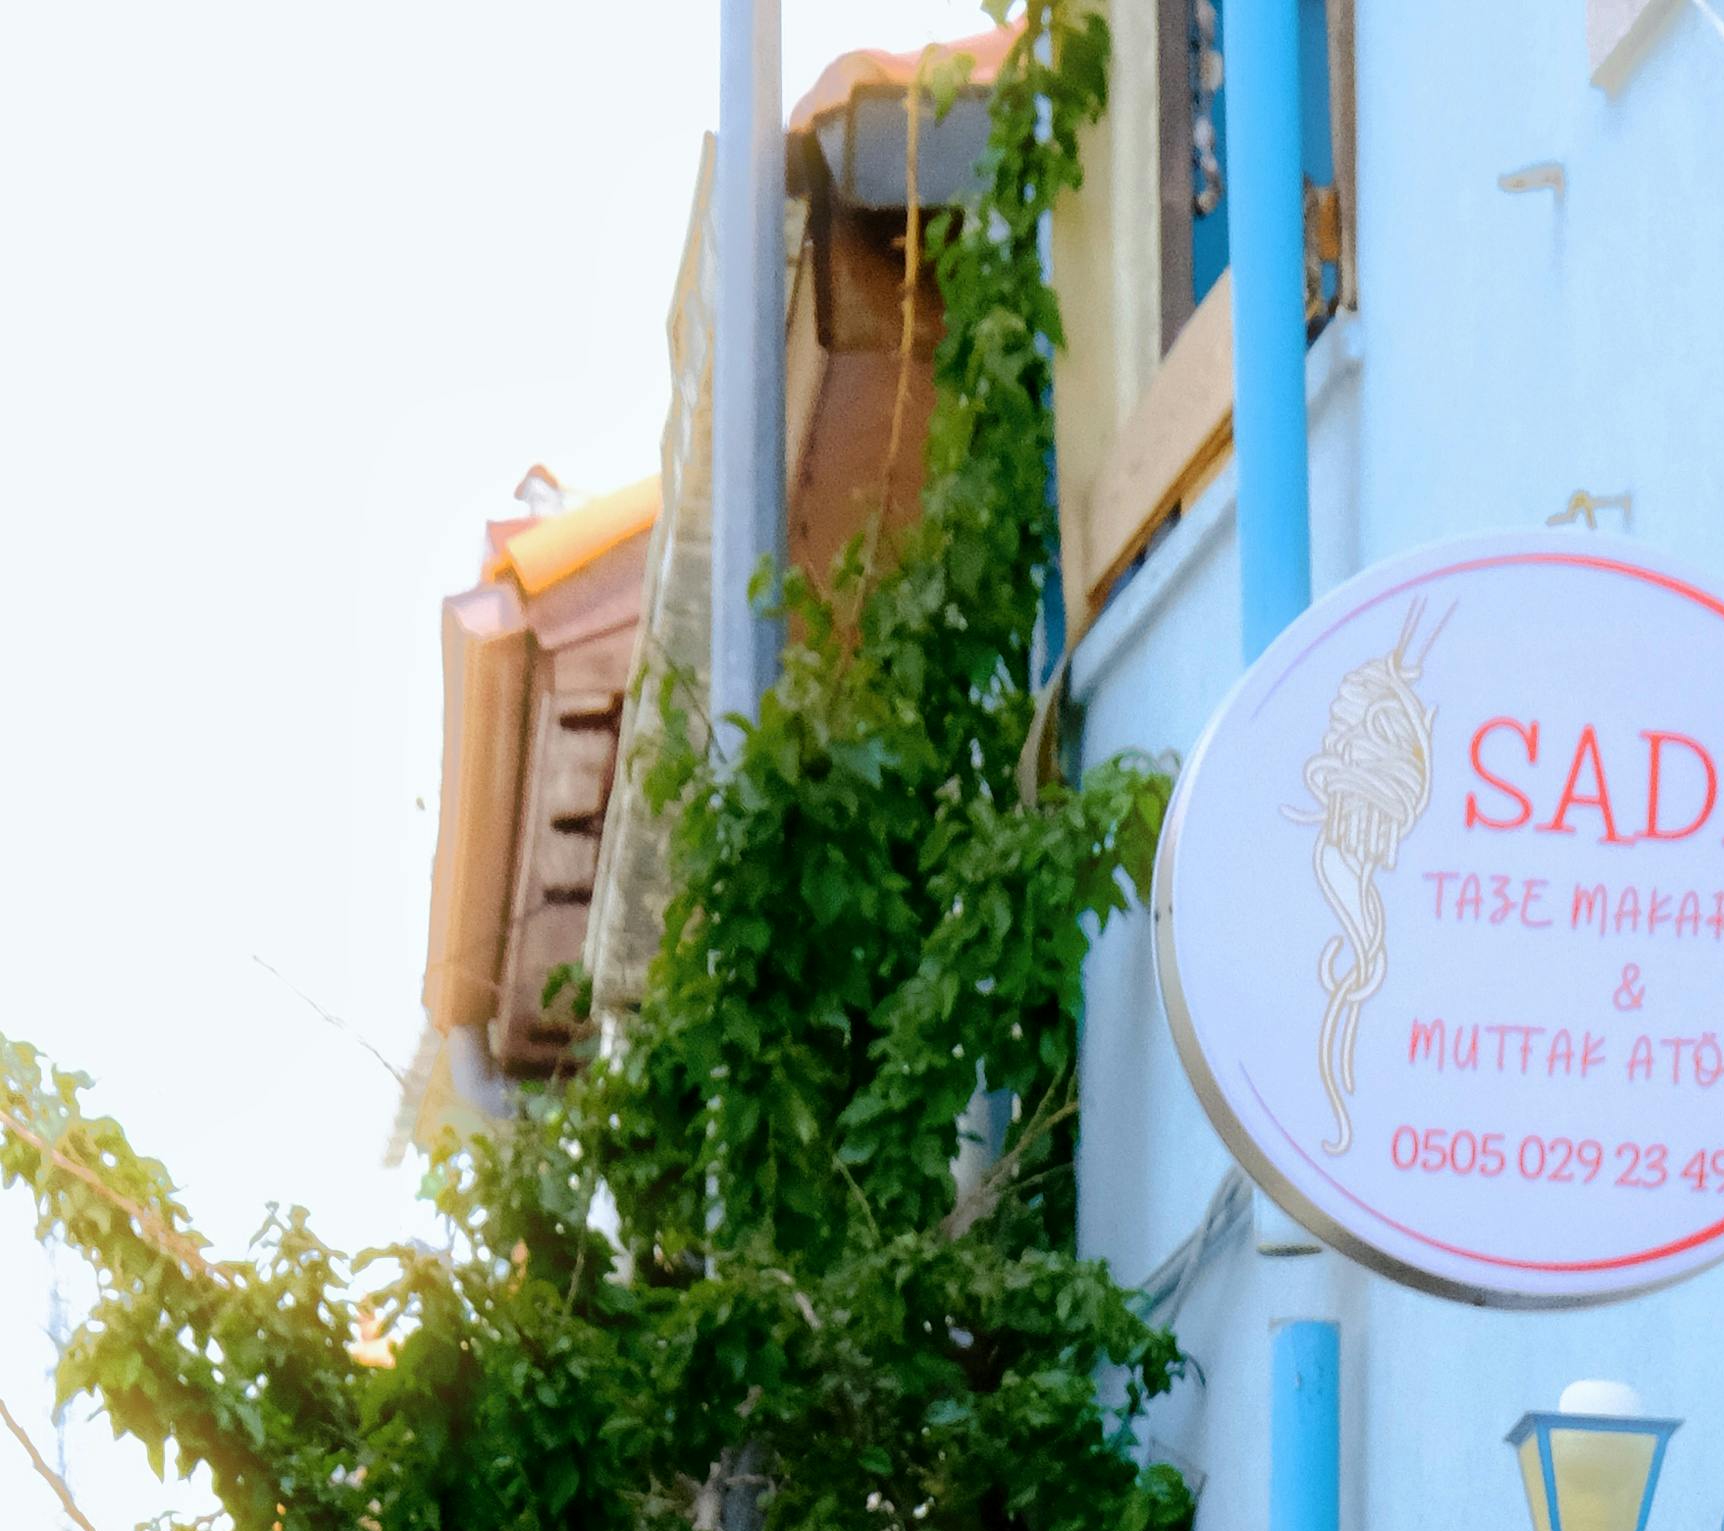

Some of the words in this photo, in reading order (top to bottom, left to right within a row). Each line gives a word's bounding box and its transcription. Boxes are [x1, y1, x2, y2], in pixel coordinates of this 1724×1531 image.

[1423, 871, 1553, 927] TAZE
[1612, 962, 1646, 1012] &
[1408, 1017, 1607, 1078] MUTFAK
[1391, 1124, 1505, 1177] 0505
[1517, 1135, 1603, 1184] 029
[1614, 1143, 1669, 1189] 23
